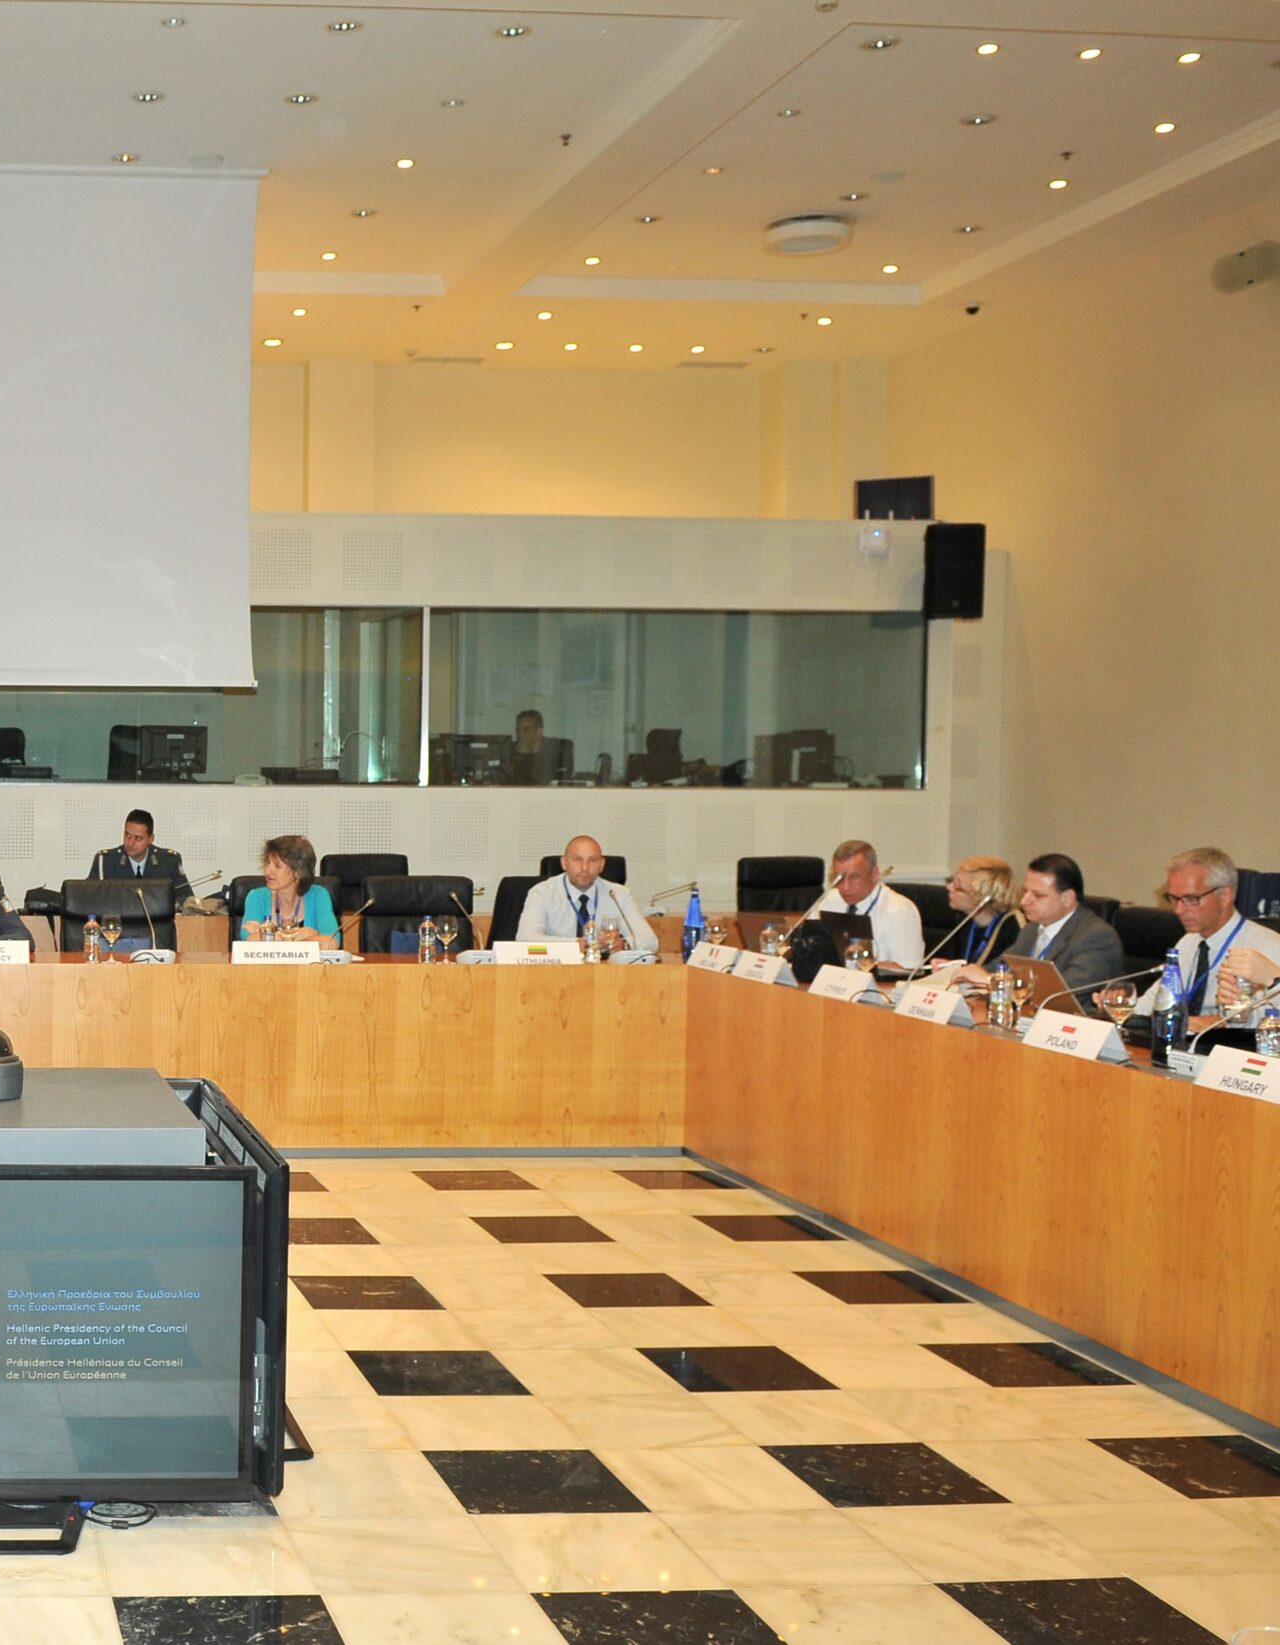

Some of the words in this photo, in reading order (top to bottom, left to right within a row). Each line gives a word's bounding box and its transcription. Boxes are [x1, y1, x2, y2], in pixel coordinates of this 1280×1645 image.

[243, 951, 310, 959] SECRETARIAT
[1045, 1034, 1079, 1051] POLAND
[1219, 1074, 1269, 1096] HUNGARY
[7, 1304, 26, 1312] της
[6, 1323, 51, 1333] Hellenic
[53, 1323, 111, 1334] Presidency
[113, 1323, 126, 1333] of
[127, 1323, 145, 1333] the
[147, 1323, 188, 1333] Council
[6, 1336, 18, 1345] of
[19, 1336, 38, 1345] the
[40, 1336, 91, 1346] European
[93, 1336, 126, 1345] Union
[6, 1358, 65, 1367] Présidence
[67, 1358, 125, 1368] Hellénique
[127, 1358, 141, 1367] du
[143, 1358, 184, 1367] Conseil
[6, 1370, 20, 1379] de
[63, 1370, 127, 1380] Européenne
